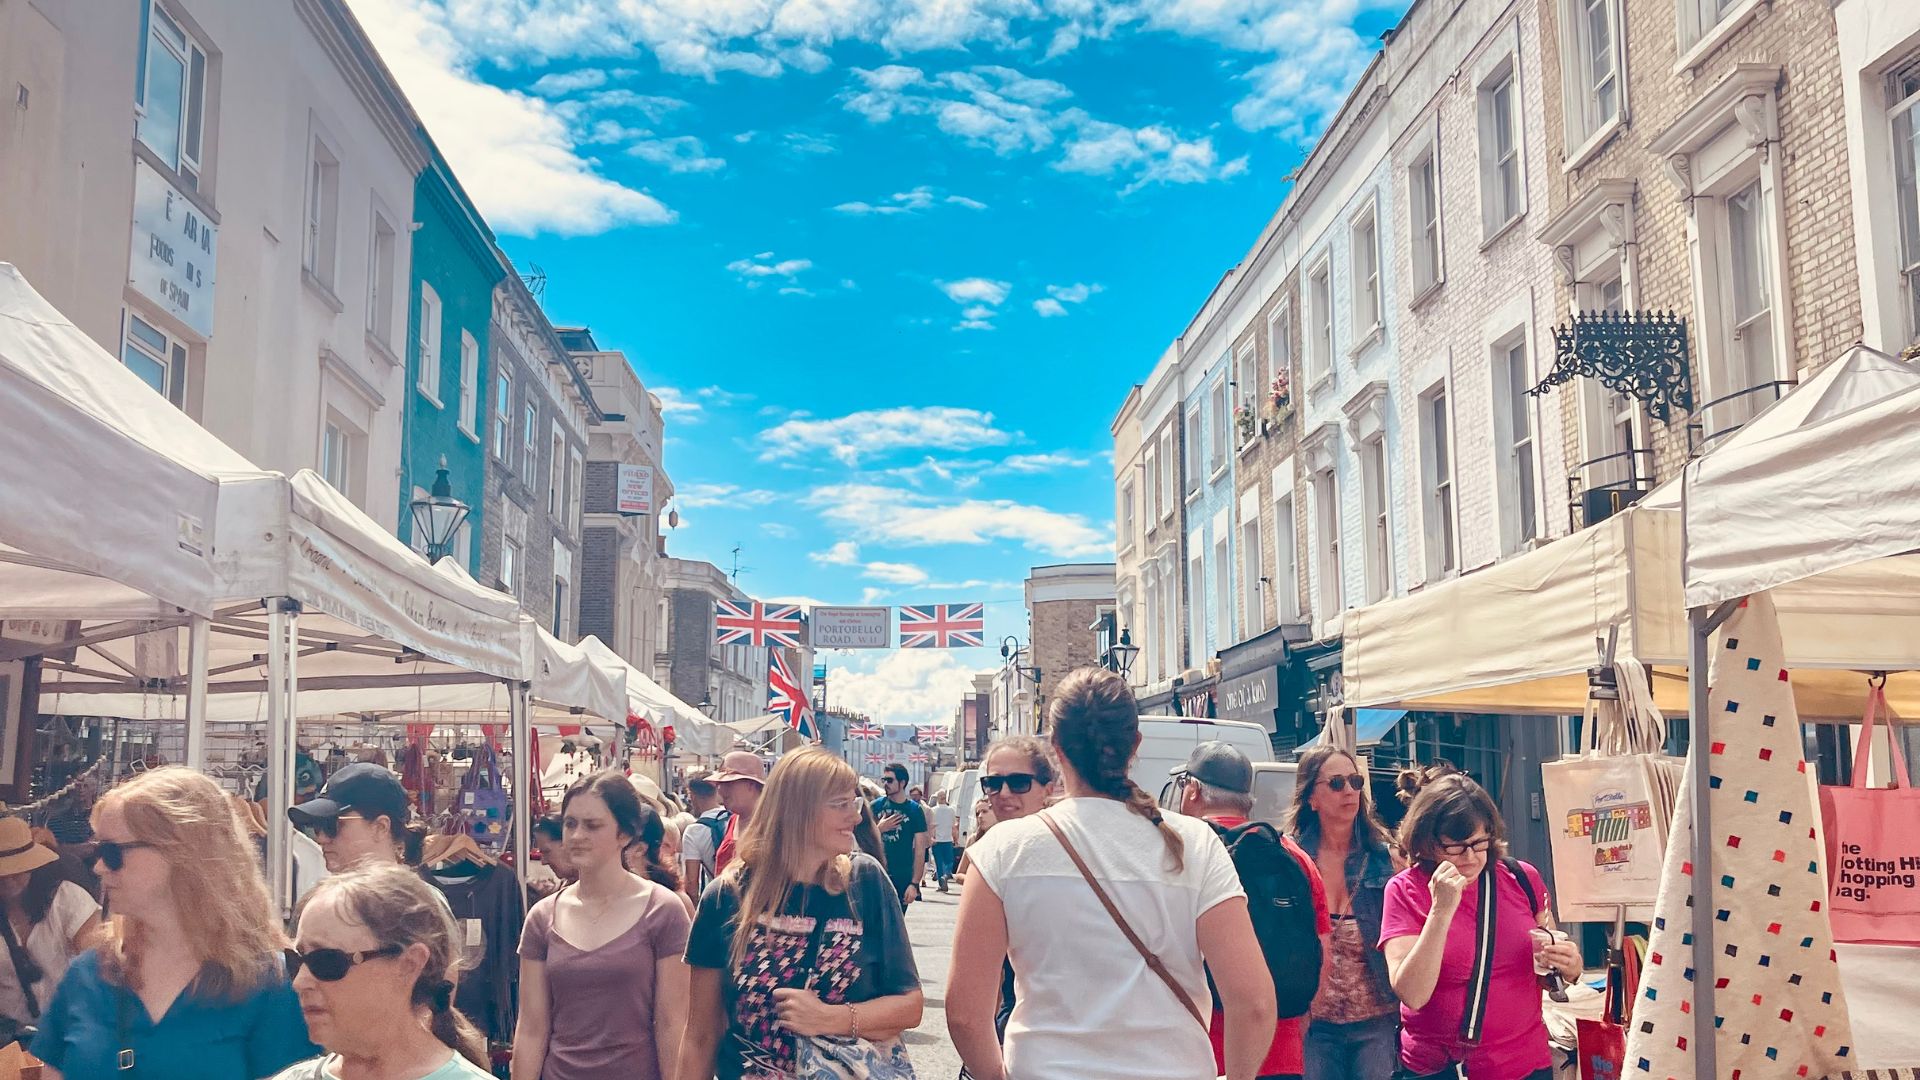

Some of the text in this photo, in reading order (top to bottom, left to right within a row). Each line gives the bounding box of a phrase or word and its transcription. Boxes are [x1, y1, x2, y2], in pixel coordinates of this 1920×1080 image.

[168, 282, 190, 312] SPAIN
[819, 624, 882, 634] PORTOBELLO
[1225, 678, 1267, 712] one of a kind
[1842, 841, 1861, 855] he
[1840, 856, 1895, 874] otting
[1840, 870, 1914, 888] hopping
